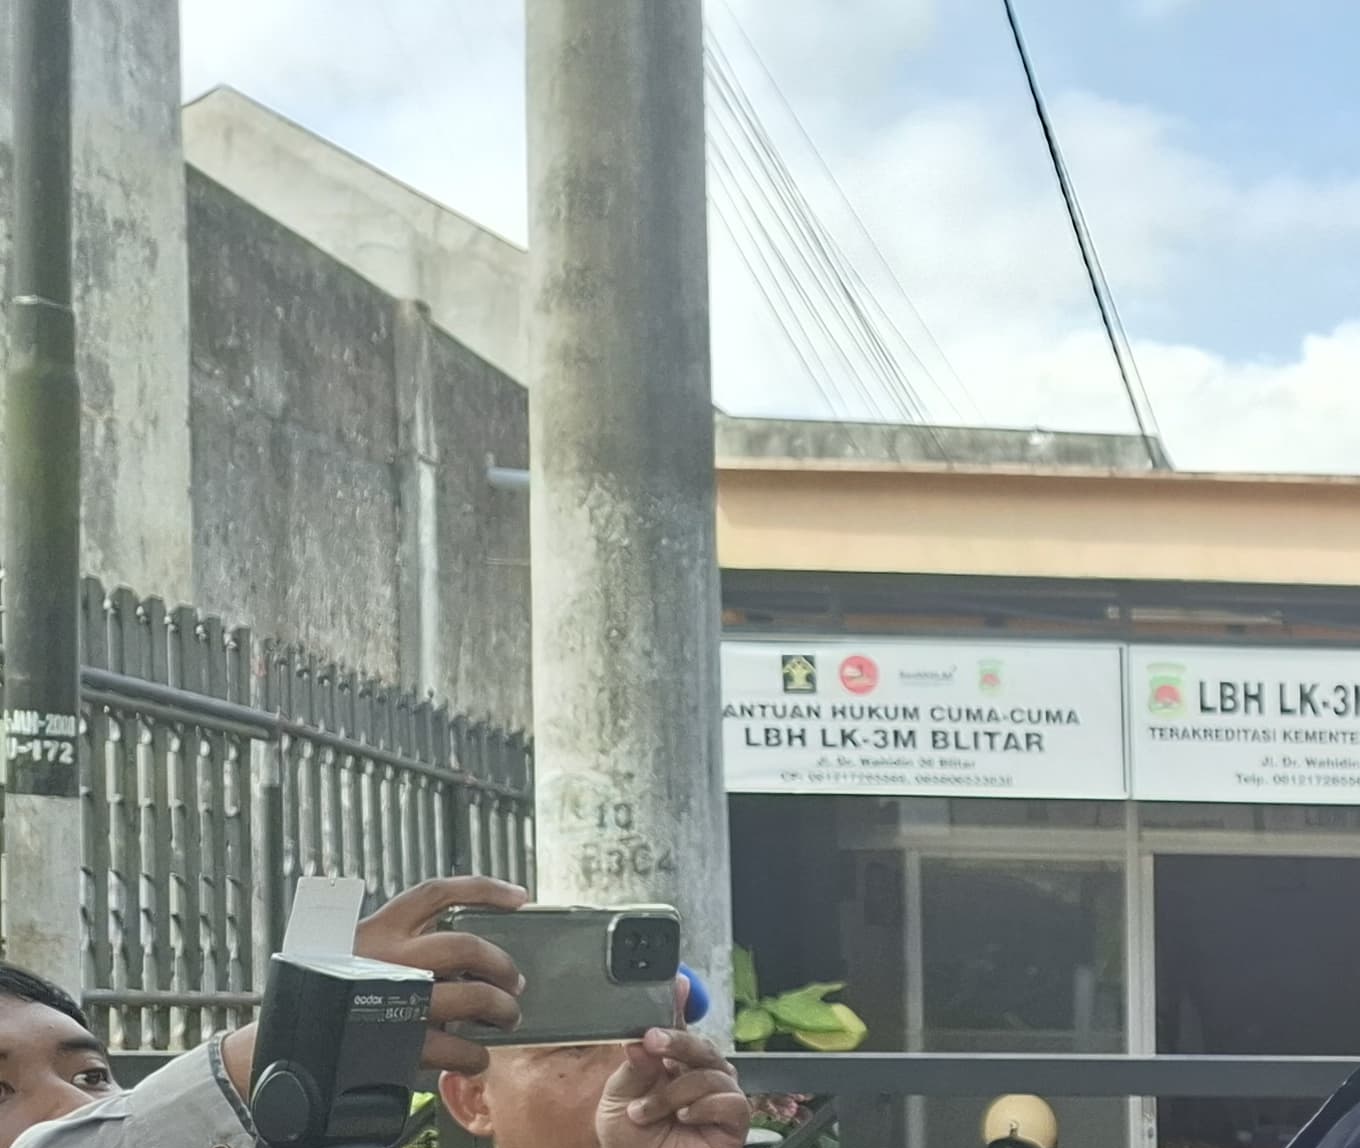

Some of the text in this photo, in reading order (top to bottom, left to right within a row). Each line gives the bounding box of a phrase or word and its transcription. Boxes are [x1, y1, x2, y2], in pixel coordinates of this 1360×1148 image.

[1200, 681, 1263, 714] LBH
[723, 704, 1081, 725] ANTUAN HUKUM CUMA-CUMA
[744, 727, 1045, 752] LBH LK-3M BLITAR
[1150, 727, 1277, 743] TERAKREDITASI
